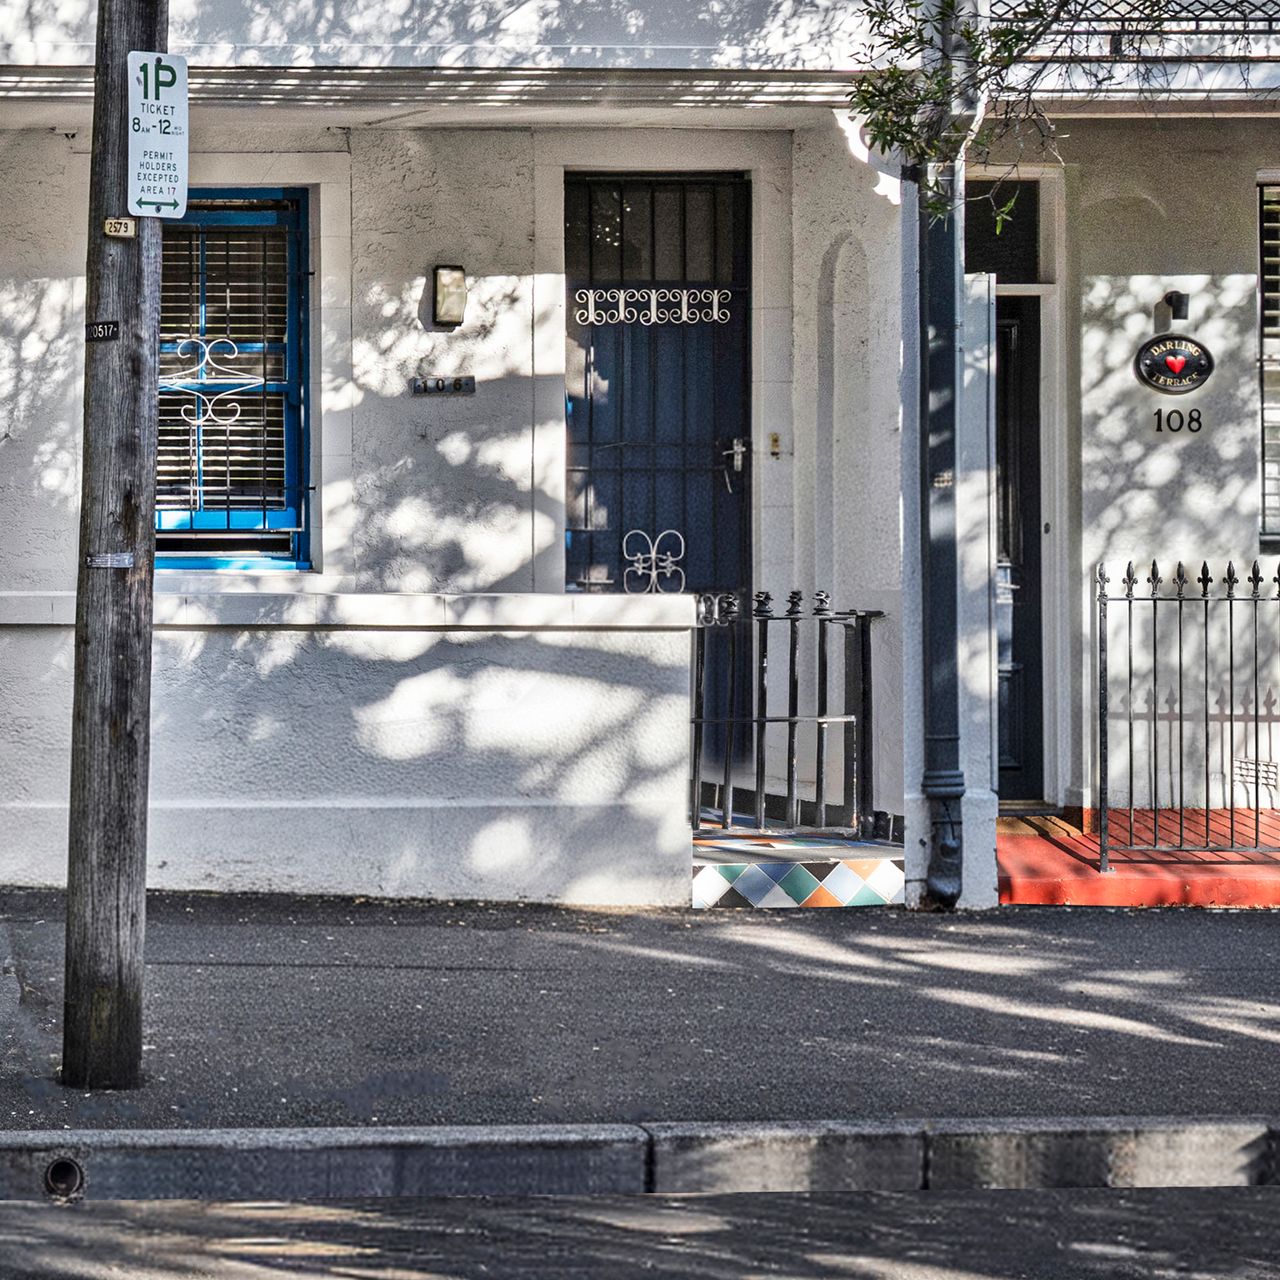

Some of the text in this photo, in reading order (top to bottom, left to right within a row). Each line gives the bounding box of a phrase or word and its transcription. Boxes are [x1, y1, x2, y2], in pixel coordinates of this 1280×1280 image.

[139, 63, 177, 101] 1P
[141, 103, 175, 116] TICKET
[143, 150, 173, 160] PERMIT
[140, 161, 177, 172] HOLDERS
[137, 172, 179, 183] EXCEPTED
[140, 186, 176, 195] AREA 17
[1150, 340, 1201, 356] DARLING
[421, 378, 463, 392] 106
[1152, 372, 1200, 386] TERRACE
[1154, 408, 1203, 432] 108
